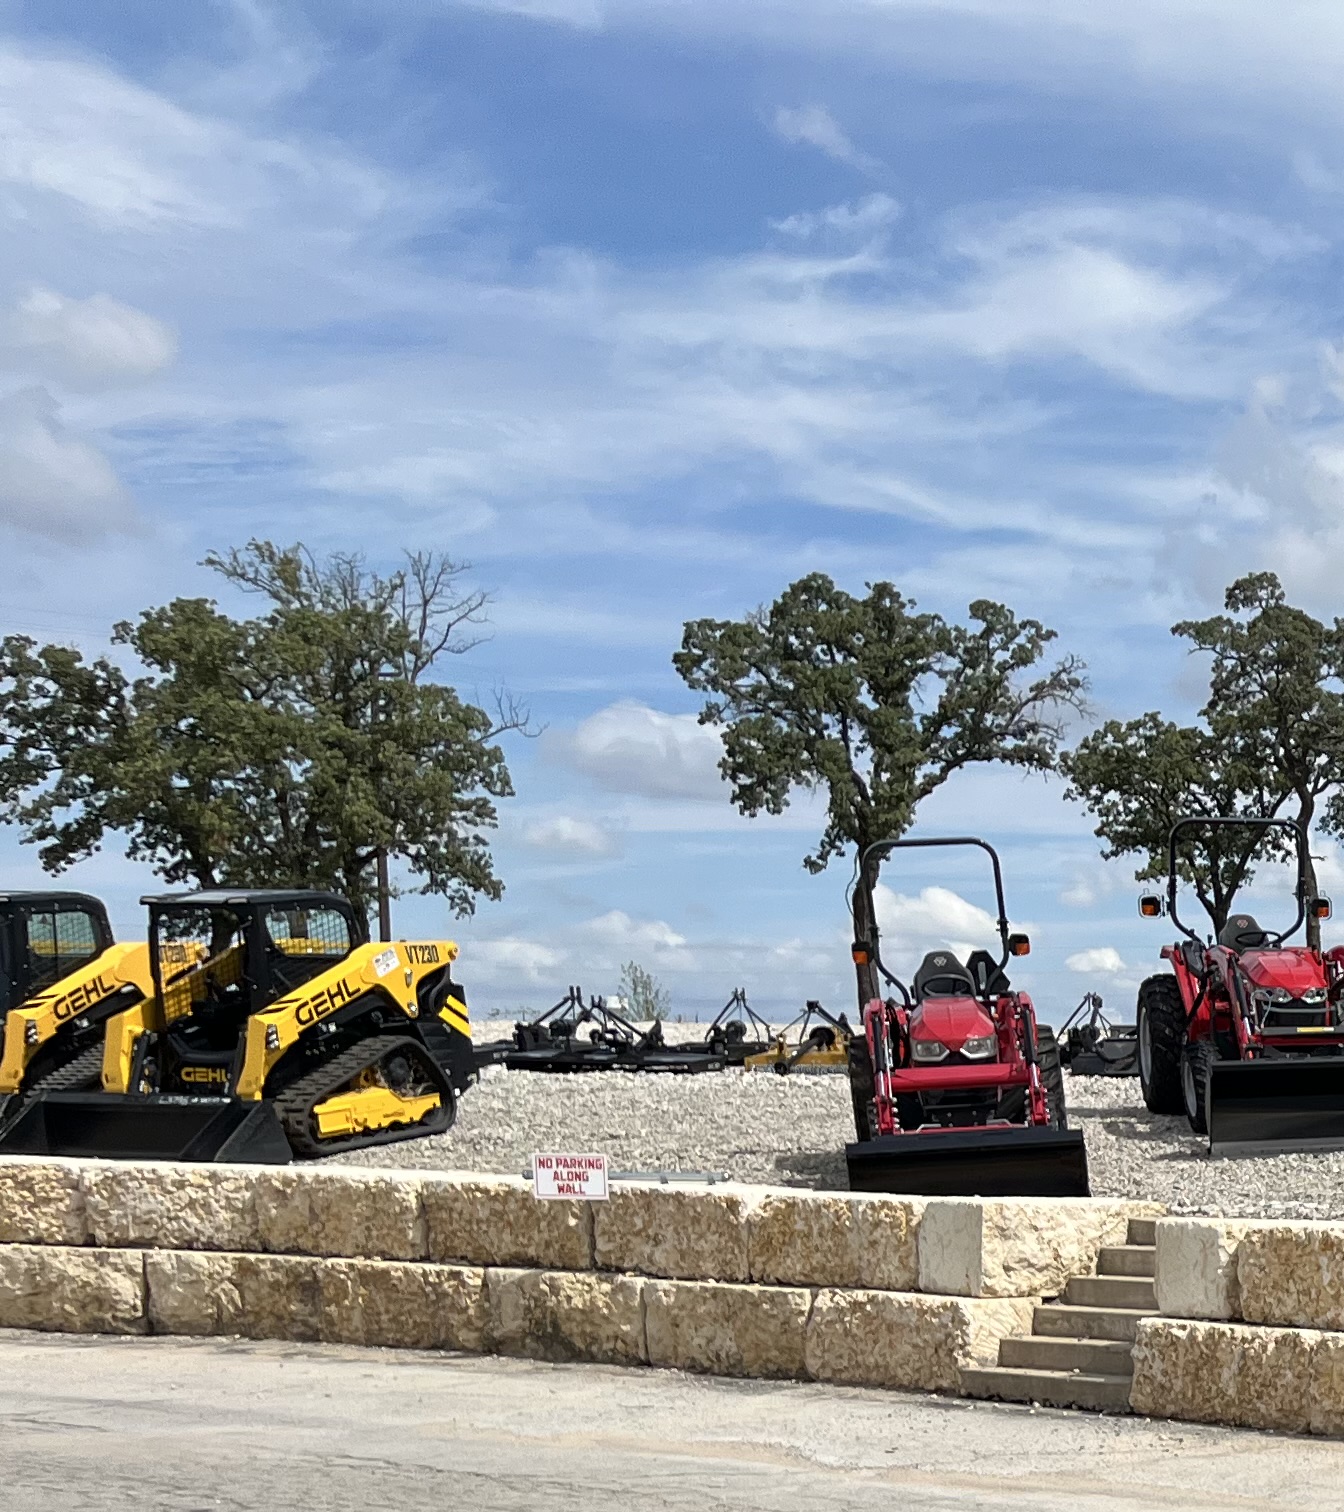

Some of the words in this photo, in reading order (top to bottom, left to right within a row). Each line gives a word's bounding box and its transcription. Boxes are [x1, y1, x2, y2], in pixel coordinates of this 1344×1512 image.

[404, 945, 440, 964] VT230
[53, 976, 115, 1020] GEHL
[295, 978, 361, 1026] GEHL
[538, 1158, 553, 1169] NO
[556, 1158, 603, 1170] PARKING
[553, 1170, 589, 1182] ALONG
[557, 1183, 586, 1196] WALL
